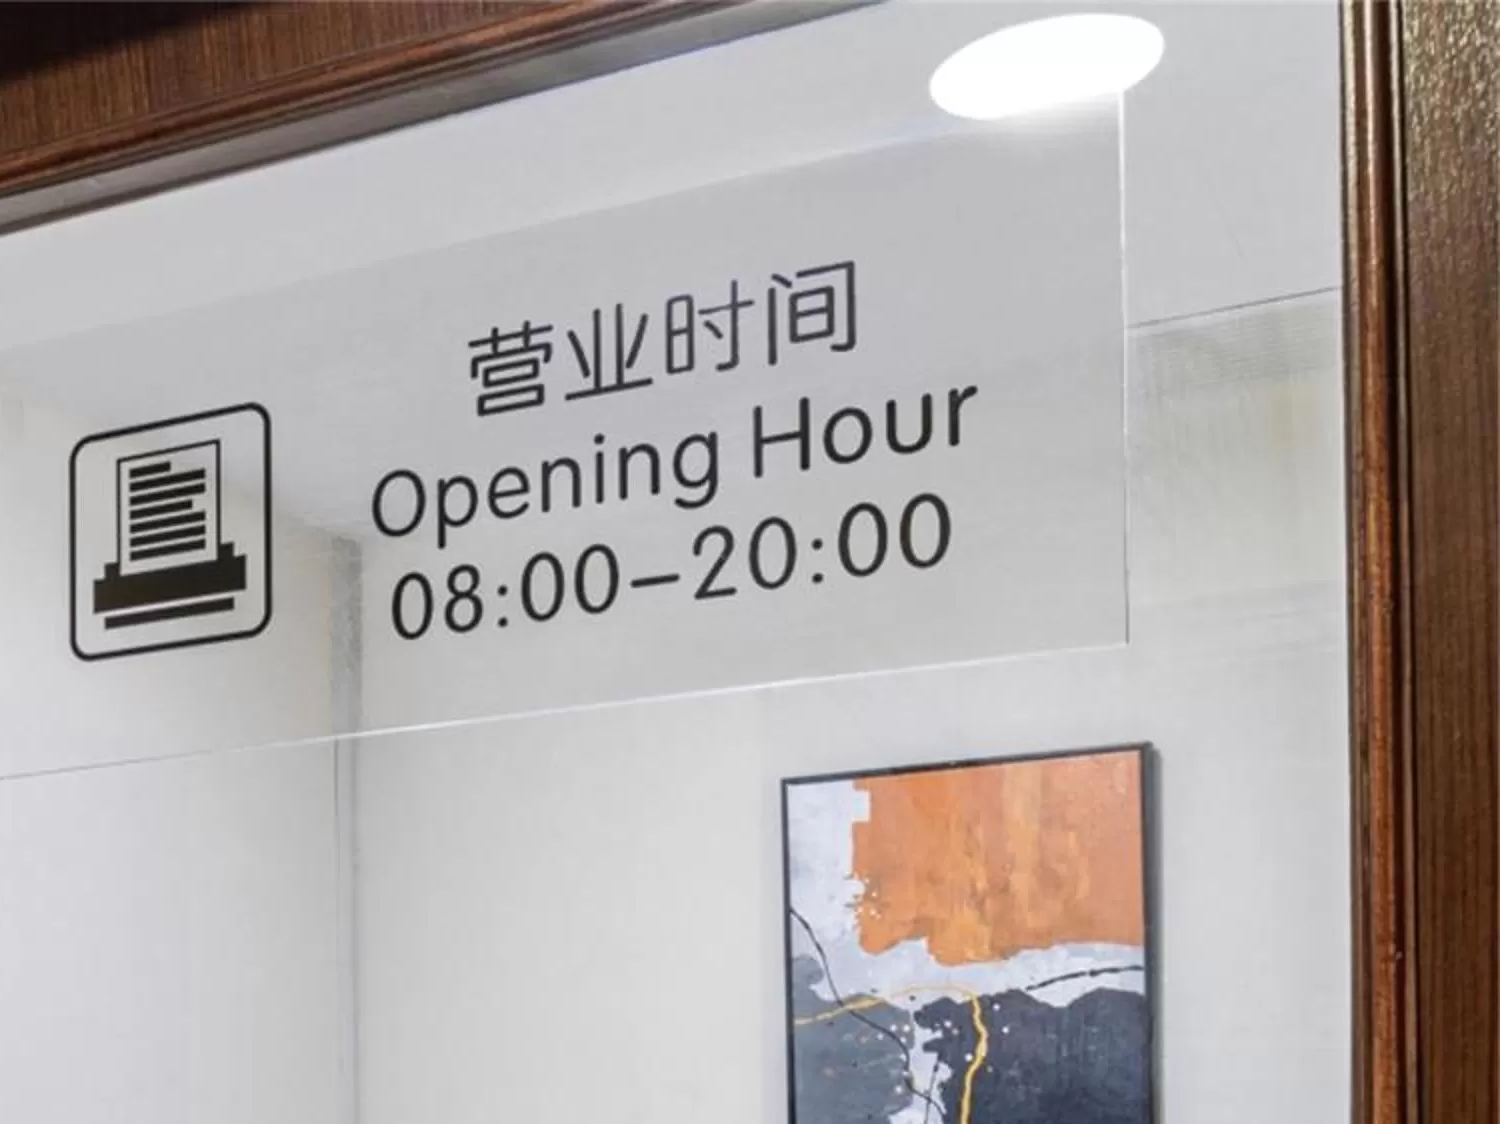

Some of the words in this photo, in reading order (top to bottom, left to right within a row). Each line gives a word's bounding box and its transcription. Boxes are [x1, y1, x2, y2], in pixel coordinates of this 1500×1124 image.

[468, 261, 857, 416] 营业时间
[372, 431, 719, 548] Opening
[751, 385, 978, 478] Hour
